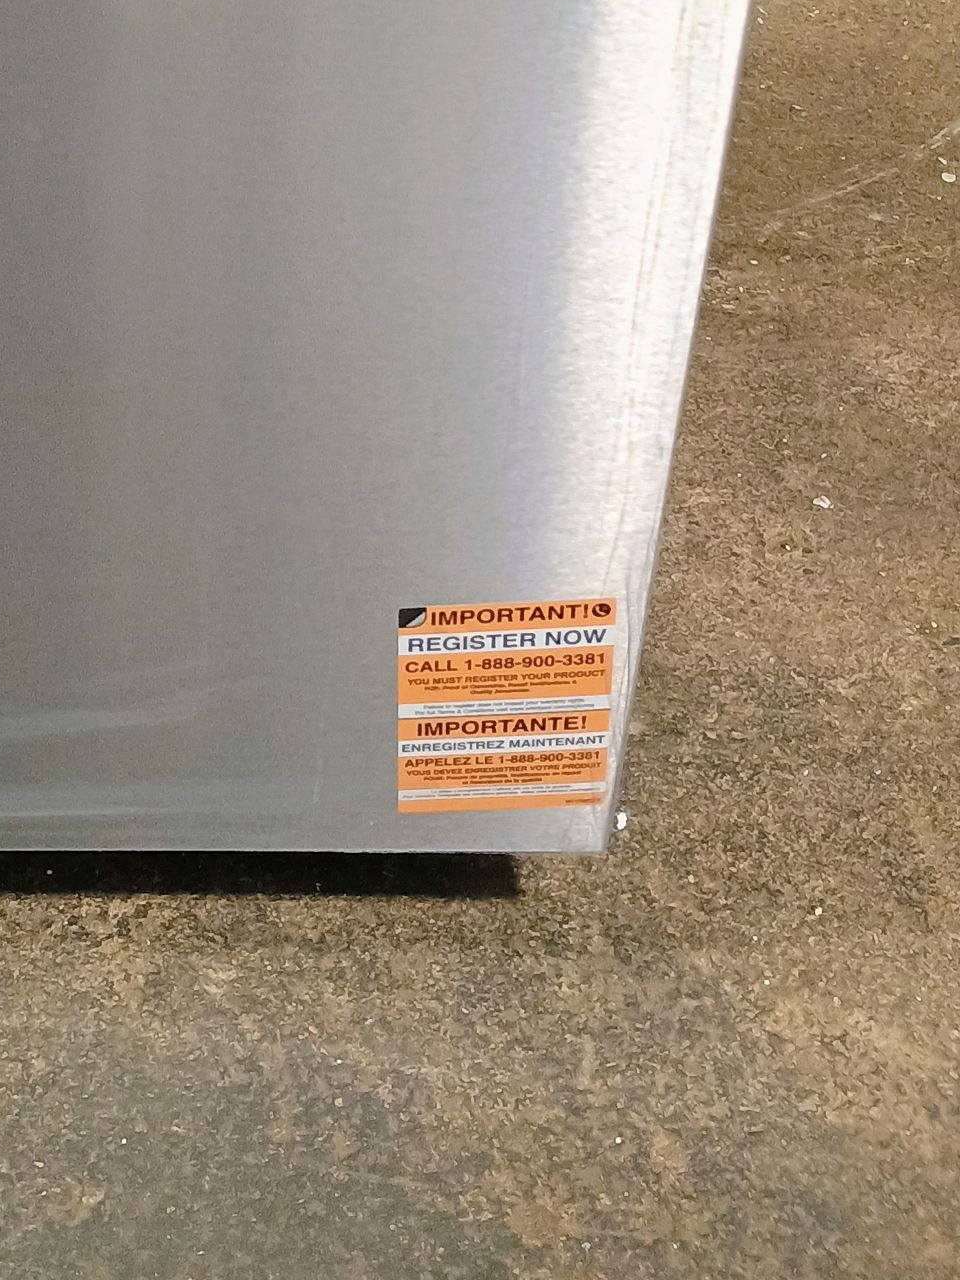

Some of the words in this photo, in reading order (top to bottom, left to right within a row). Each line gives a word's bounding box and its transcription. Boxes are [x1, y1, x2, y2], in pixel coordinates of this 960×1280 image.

[431, 604, 589, 626] IMPORTANT!
[408, 632, 536, 652] REGISTER
[545, 629, 607, 646] NOW
[405, 660, 458, 673] CALL
[464, 653, 605, 671] 1-888-900-3381
[407, 678, 430, 686] YOU
[433, 676, 463, 685] MUST
[465, 674, 518, 683] REGISTER
[520, 672, 551, 680] YOUR
[554, 669, 606, 679] PRODUCT
[417, 716, 587, 737] IMPORTANTE!
[401, 740, 505, 753] ENREGISTREZ
[509, 735, 606, 748] MAINTENANT
[404, 756, 471, 768] APPELEZ
[475, 756, 493, 765] LE
[498, 751, 600, 764] 1-888-900-3381
[562, 762, 602, 770] PRODUIT
